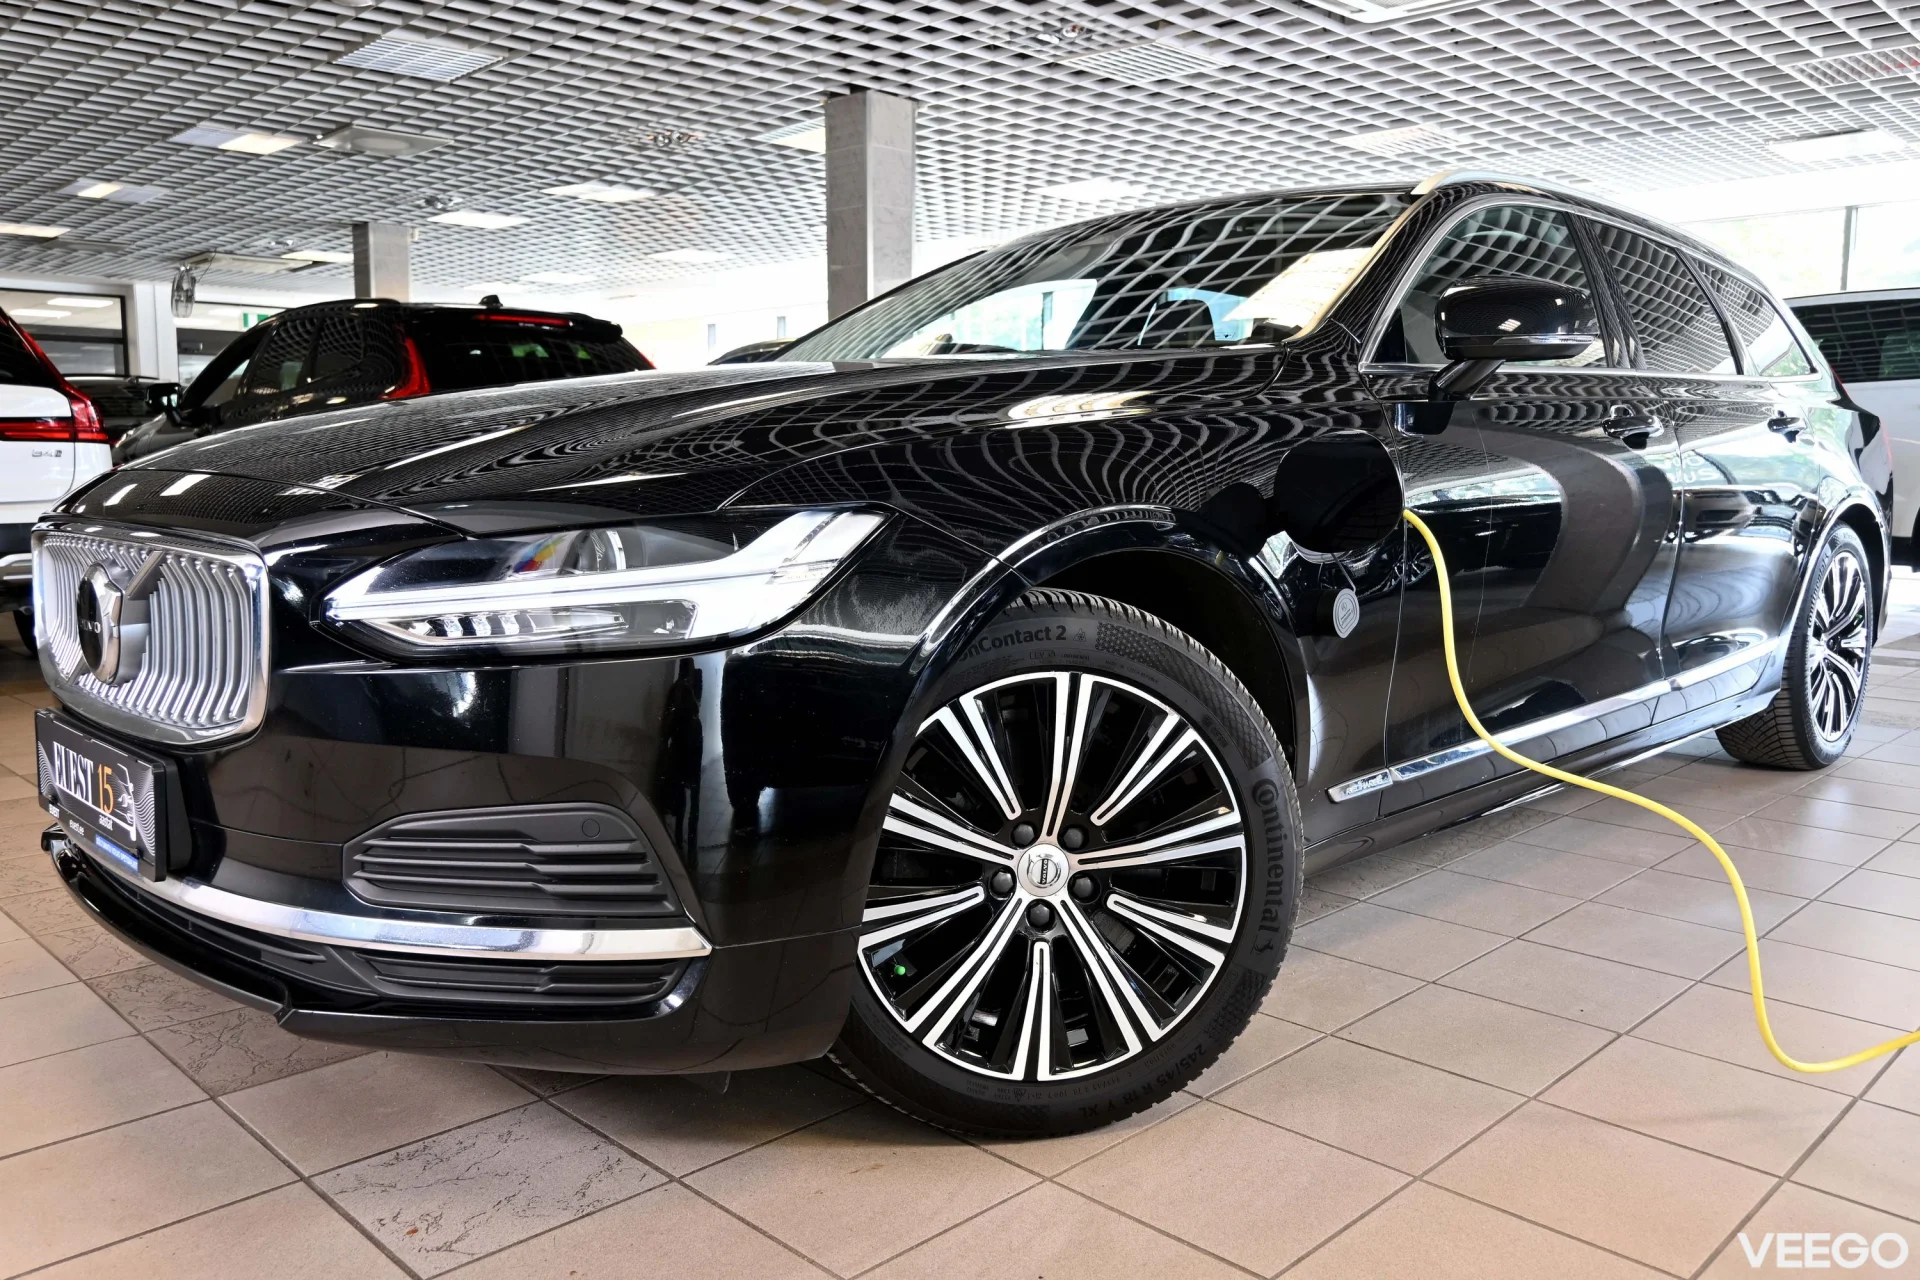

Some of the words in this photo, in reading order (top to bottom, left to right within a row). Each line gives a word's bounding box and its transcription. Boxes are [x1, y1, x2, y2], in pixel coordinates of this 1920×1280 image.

[1056, 625, 1067, 641] 2
[97, 763, 114, 814] 15
[1252, 777, 1288, 934] Continental
